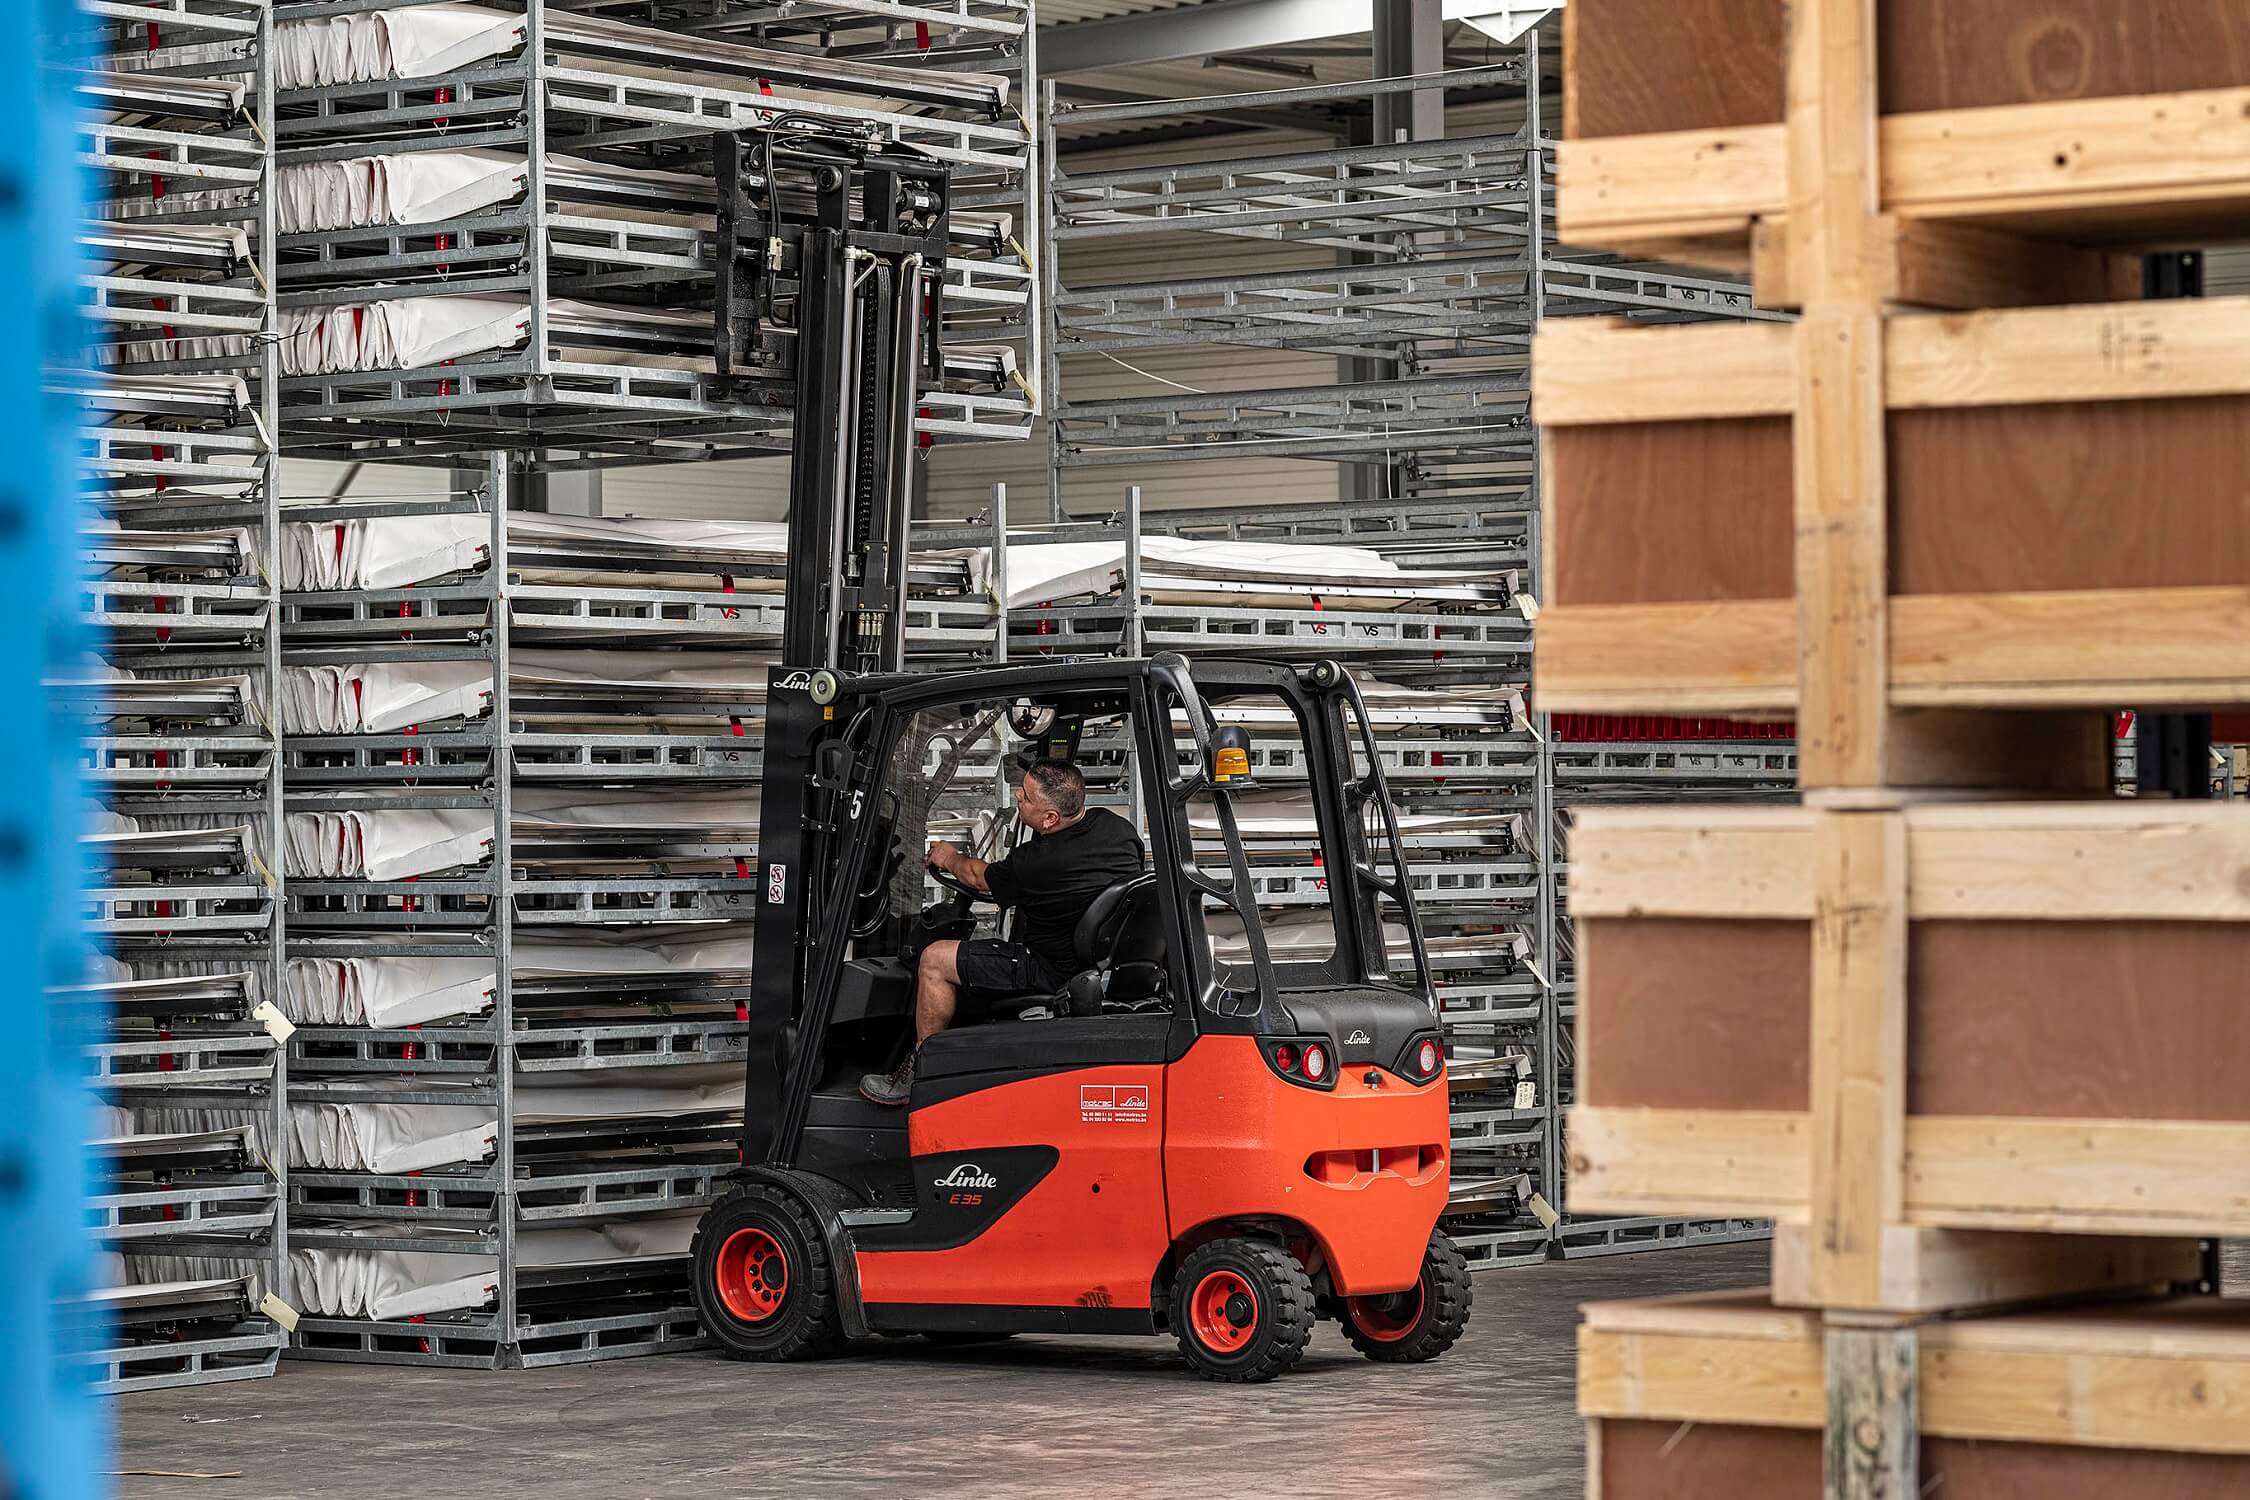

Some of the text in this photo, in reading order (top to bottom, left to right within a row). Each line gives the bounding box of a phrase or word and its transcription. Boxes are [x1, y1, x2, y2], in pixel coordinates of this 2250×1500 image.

[753, 109, 773, 122] VS
[1680, 289, 1696, 300] VS
[720, 607, 740, 619] VS
[1311, 623, 1327, 634] VS
[1362, 625, 1379, 636] VS
[772, 671, 811, 690] Lin
[722, 752, 740, 761] VS
[850, 789, 865, 820] 5
[724, 895, 740, 904] VS
[1343, 1030, 1371, 1044] Linde
[1120, 1096, 1146, 1107] Linde
[934, 1164, 998, 1188] Linde
